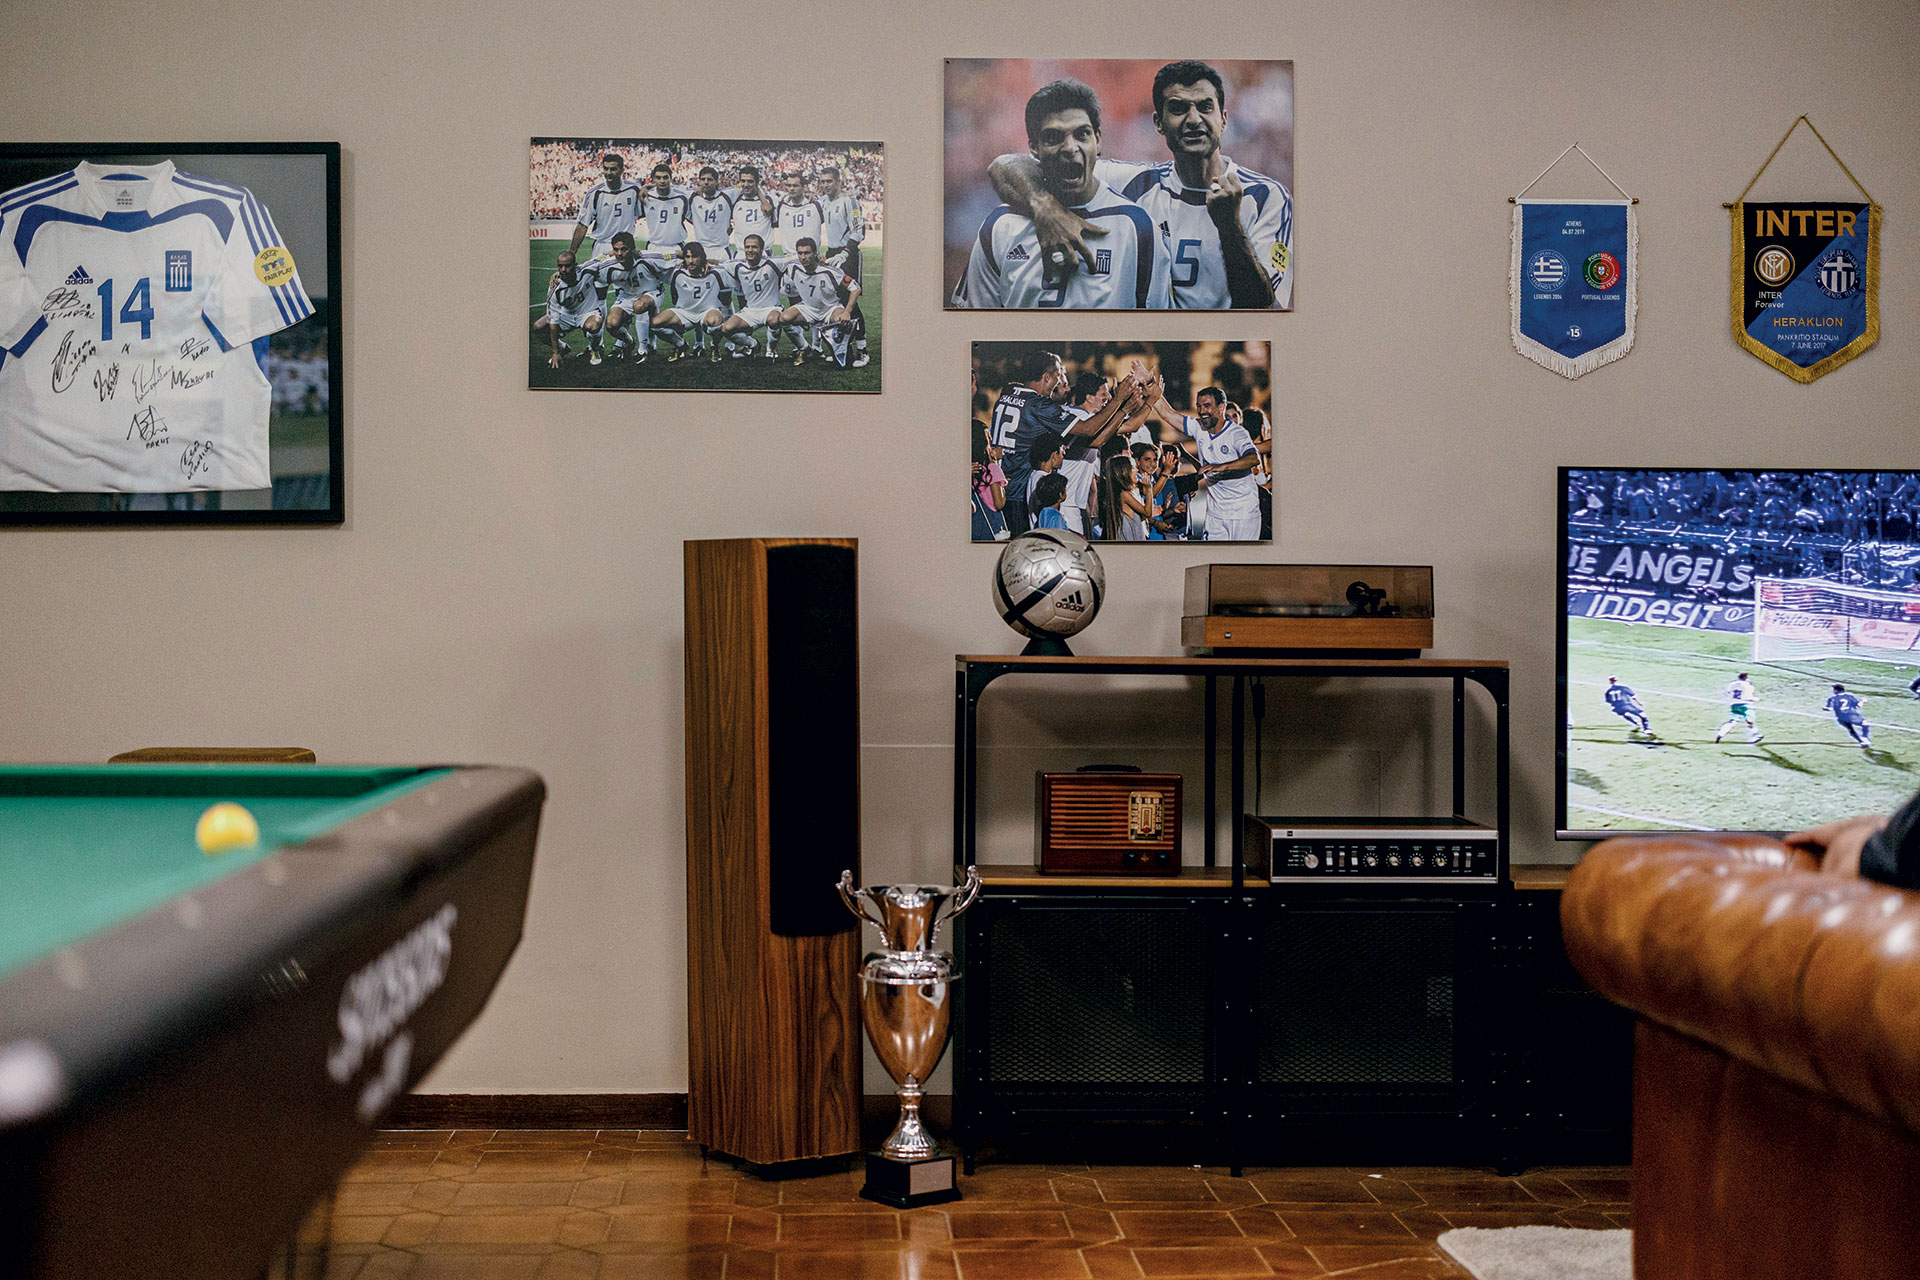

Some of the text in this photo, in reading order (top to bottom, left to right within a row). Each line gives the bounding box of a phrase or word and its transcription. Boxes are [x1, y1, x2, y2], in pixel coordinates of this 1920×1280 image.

[614, 203, 622, 217] 5
[659, 210, 668, 223] 9
[704, 210, 717, 223] 14
[745, 208, 758, 223] 21
[792, 214, 804, 228] 19
[1756, 210, 1857, 237] INTER
[1172, 239, 1202, 287] 5
[1588, 252, 1613, 262] PORTUGAL
[264, 266, 293, 282] FAIR PLAY
[753, 279, 762, 292] 6
[808, 285, 816, 297] 7
[693, 286, 701, 299] 2
[1758, 291, 1782, 299] INTER
[97, 277, 154, 341] 14
[1755, 300, 1784, 308] Forever
[1773, 317, 1843, 327] HERAKLION
[992, 403, 1021, 449] 12
[1606, 546, 1754, 592] ANGELS
[1055, 602, 1085, 612] adidas
[1840, 698, 1849, 710] 2
